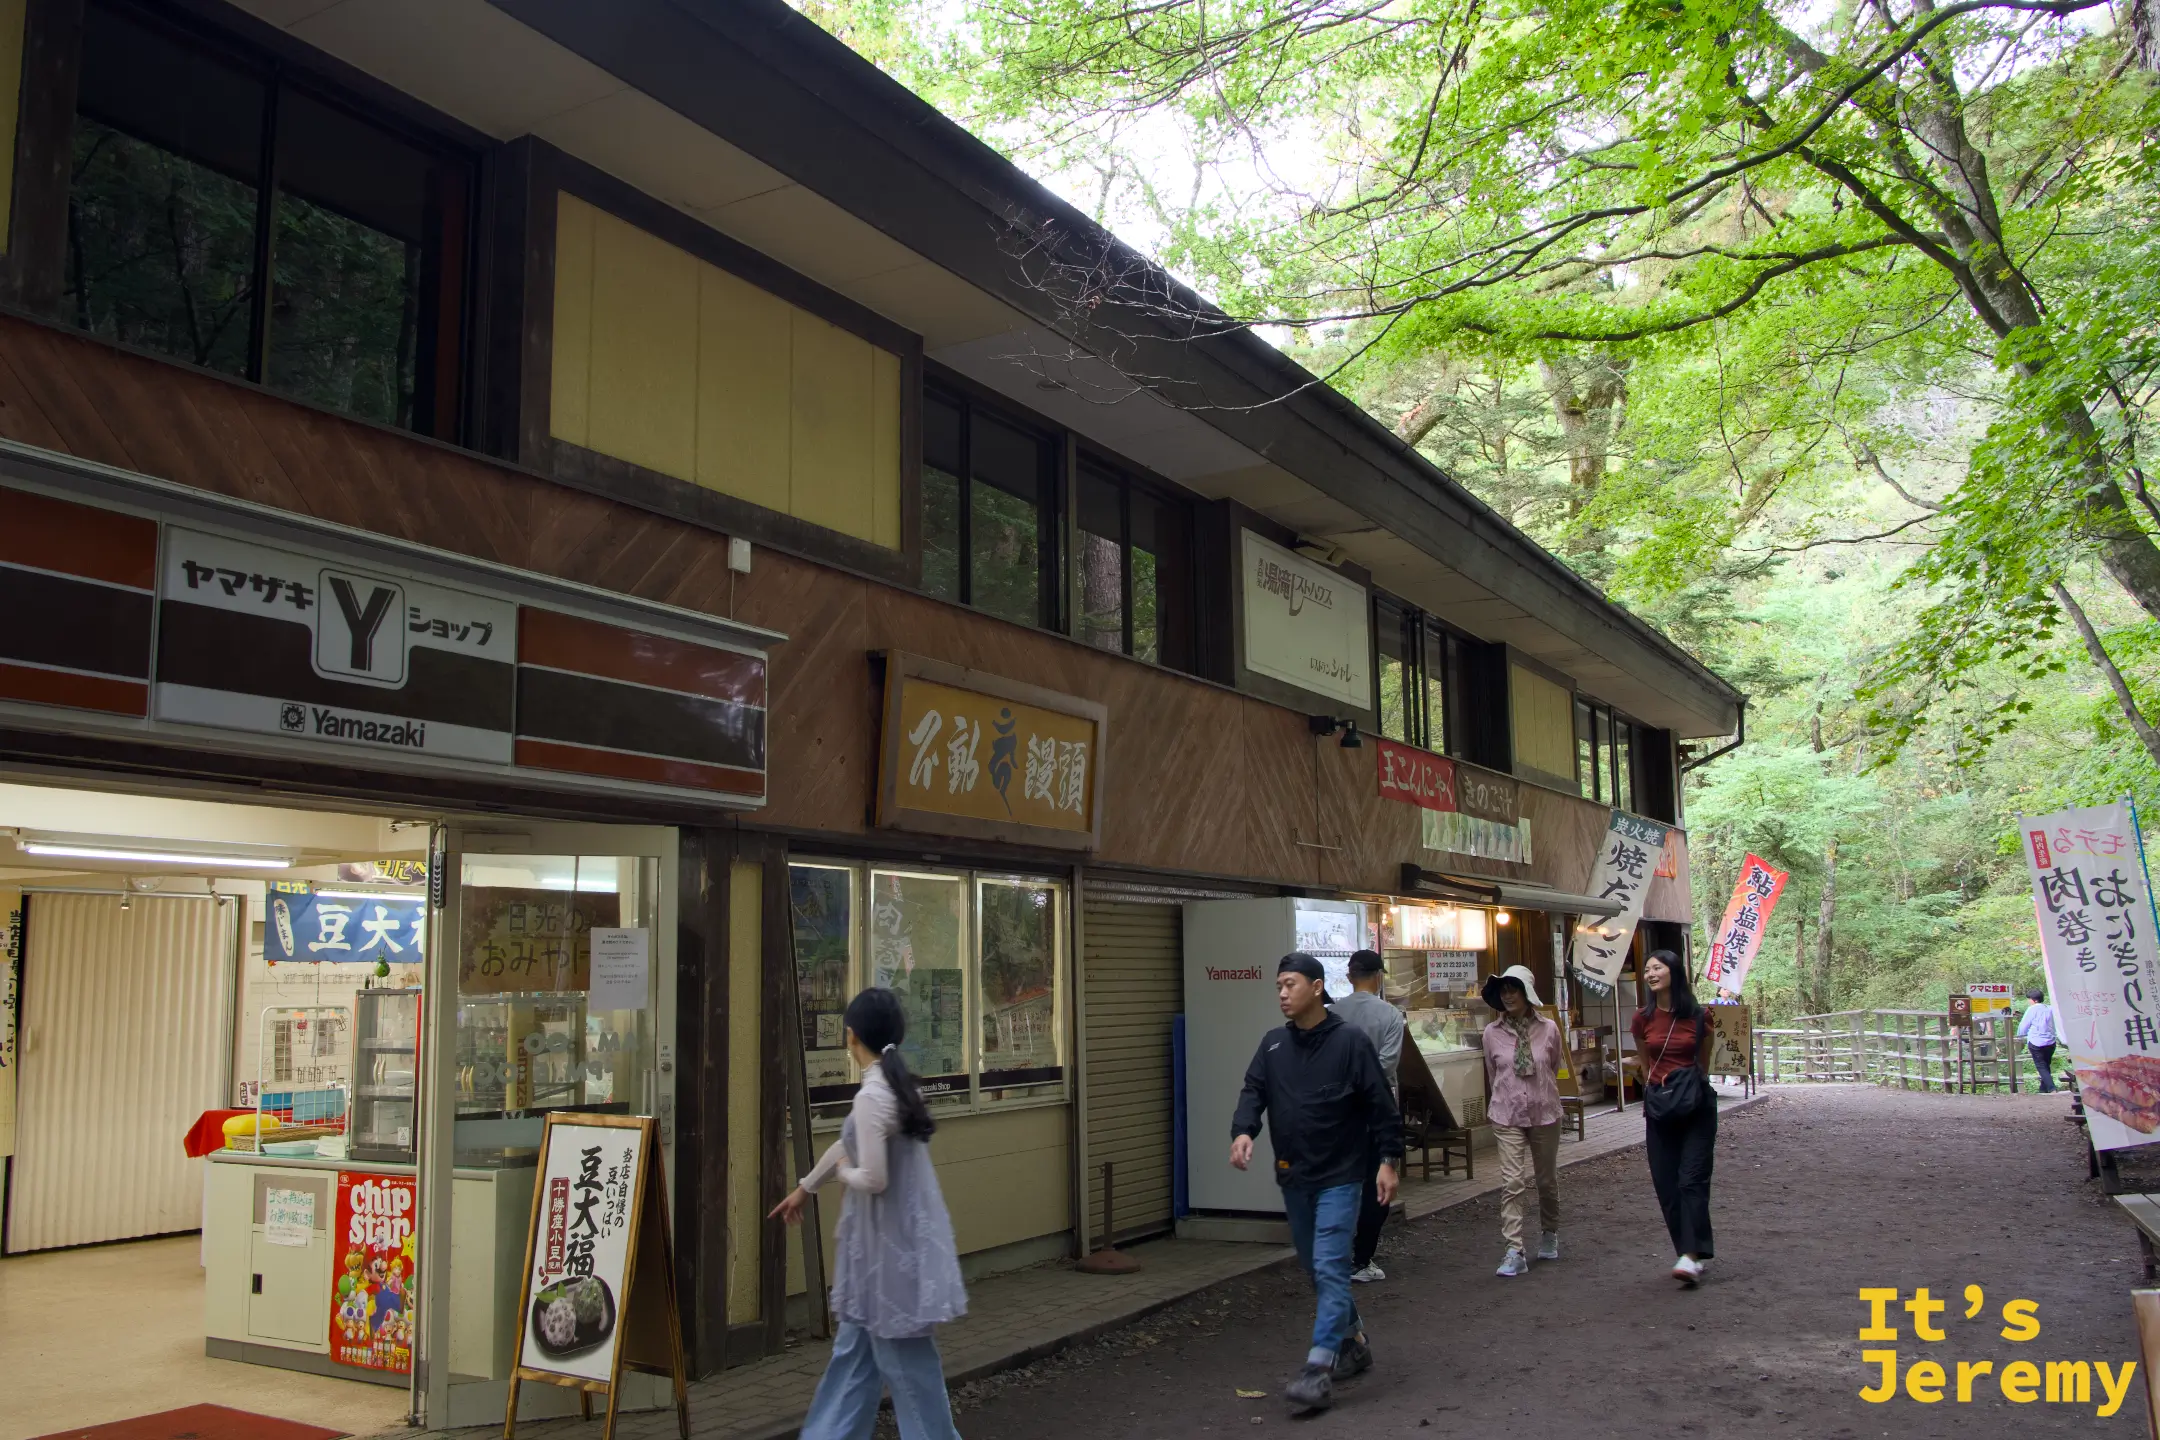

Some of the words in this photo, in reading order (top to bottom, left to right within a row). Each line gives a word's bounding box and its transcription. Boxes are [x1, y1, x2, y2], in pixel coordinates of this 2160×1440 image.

[181, 559, 315, 611] ヤマザキ
[328, 576, 397, 673] Y
[408, 605, 494, 648] ショップ
[311, 707, 426, 748] Yamazaki
[1463, 775, 1513, 820] きのこ汁
[1613, 816, 1661, 846] 炭火焼
[508, 902, 585, 933] 日光の
[1721, 866, 1775, 975] 鮎の塩焼き
[1205, 964, 1262, 981] Yamazaki
[350, 1178, 411, 1217] chip
[601, 1166, 619, 1239] 豆いっぱい
[613, 1147, 634, 1229] 当店自慢の
[349, 1211, 411, 1250] star
[563, 1145, 604, 1279] 豆大福
